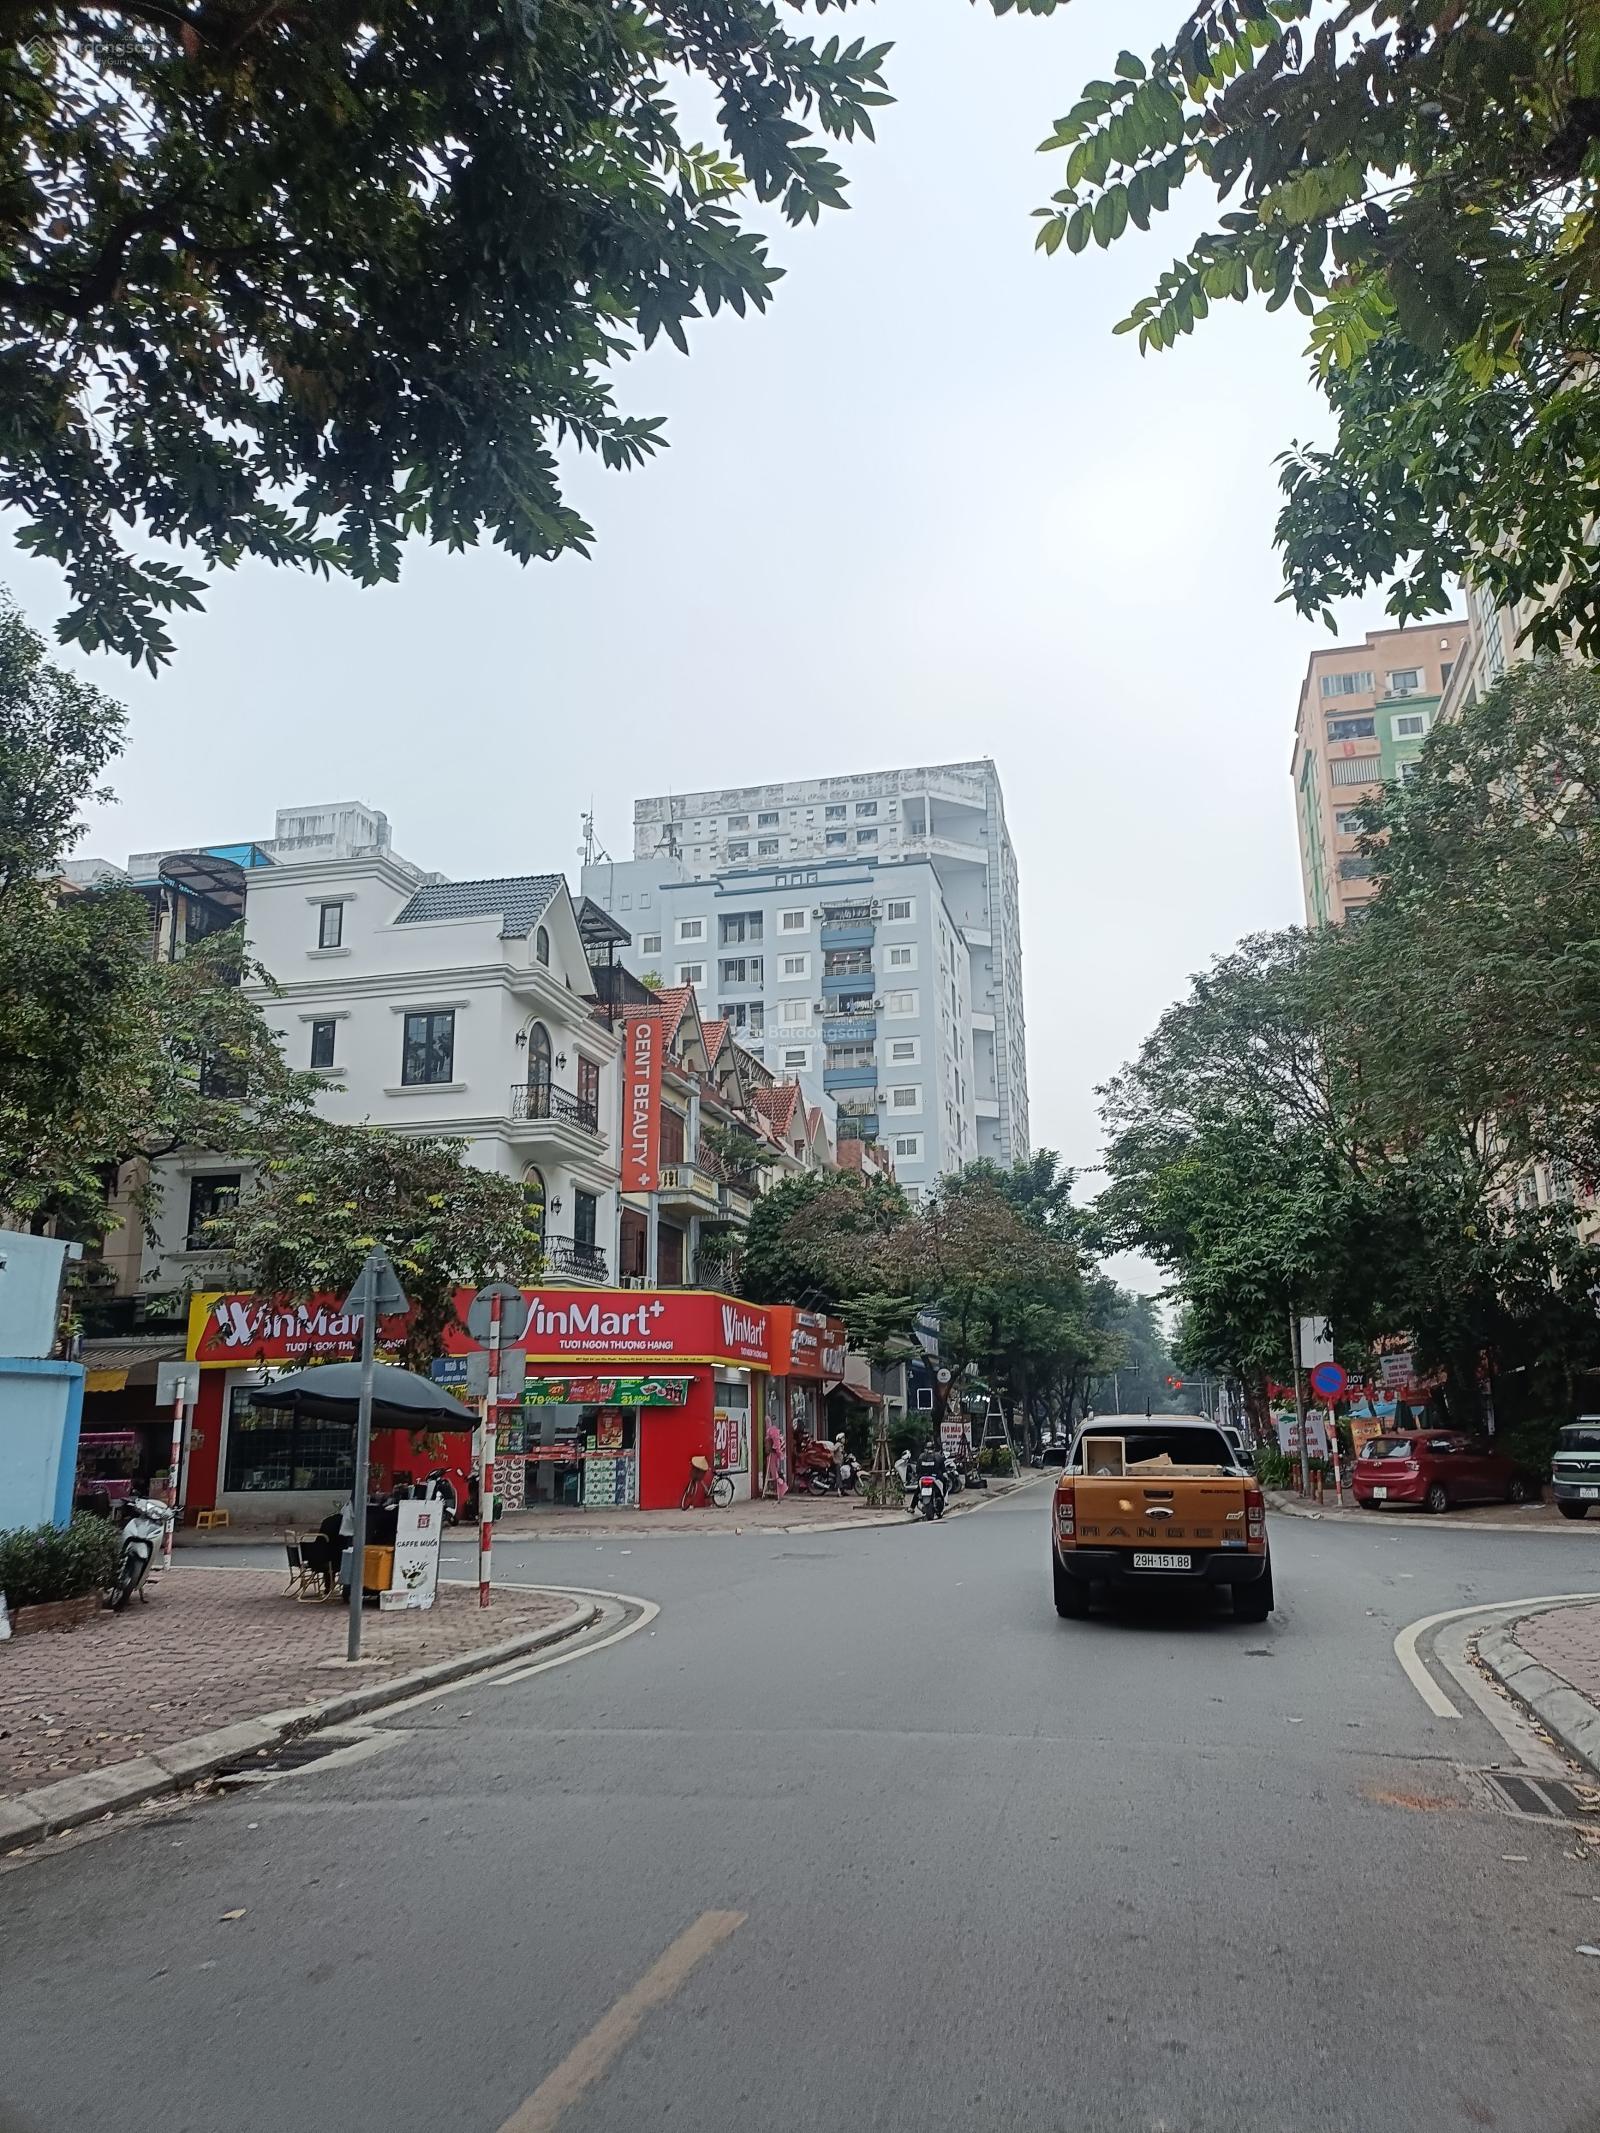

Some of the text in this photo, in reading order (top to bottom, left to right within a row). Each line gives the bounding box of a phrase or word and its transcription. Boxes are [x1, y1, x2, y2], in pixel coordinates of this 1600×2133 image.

[631, 1024, 652, 1168] CENT BEAUTY
[517, 1296, 665, 1342] inMart+
[582, 1339, 609, 1350] NGON
[1080, 1525, 1244, 1540] RANGER
